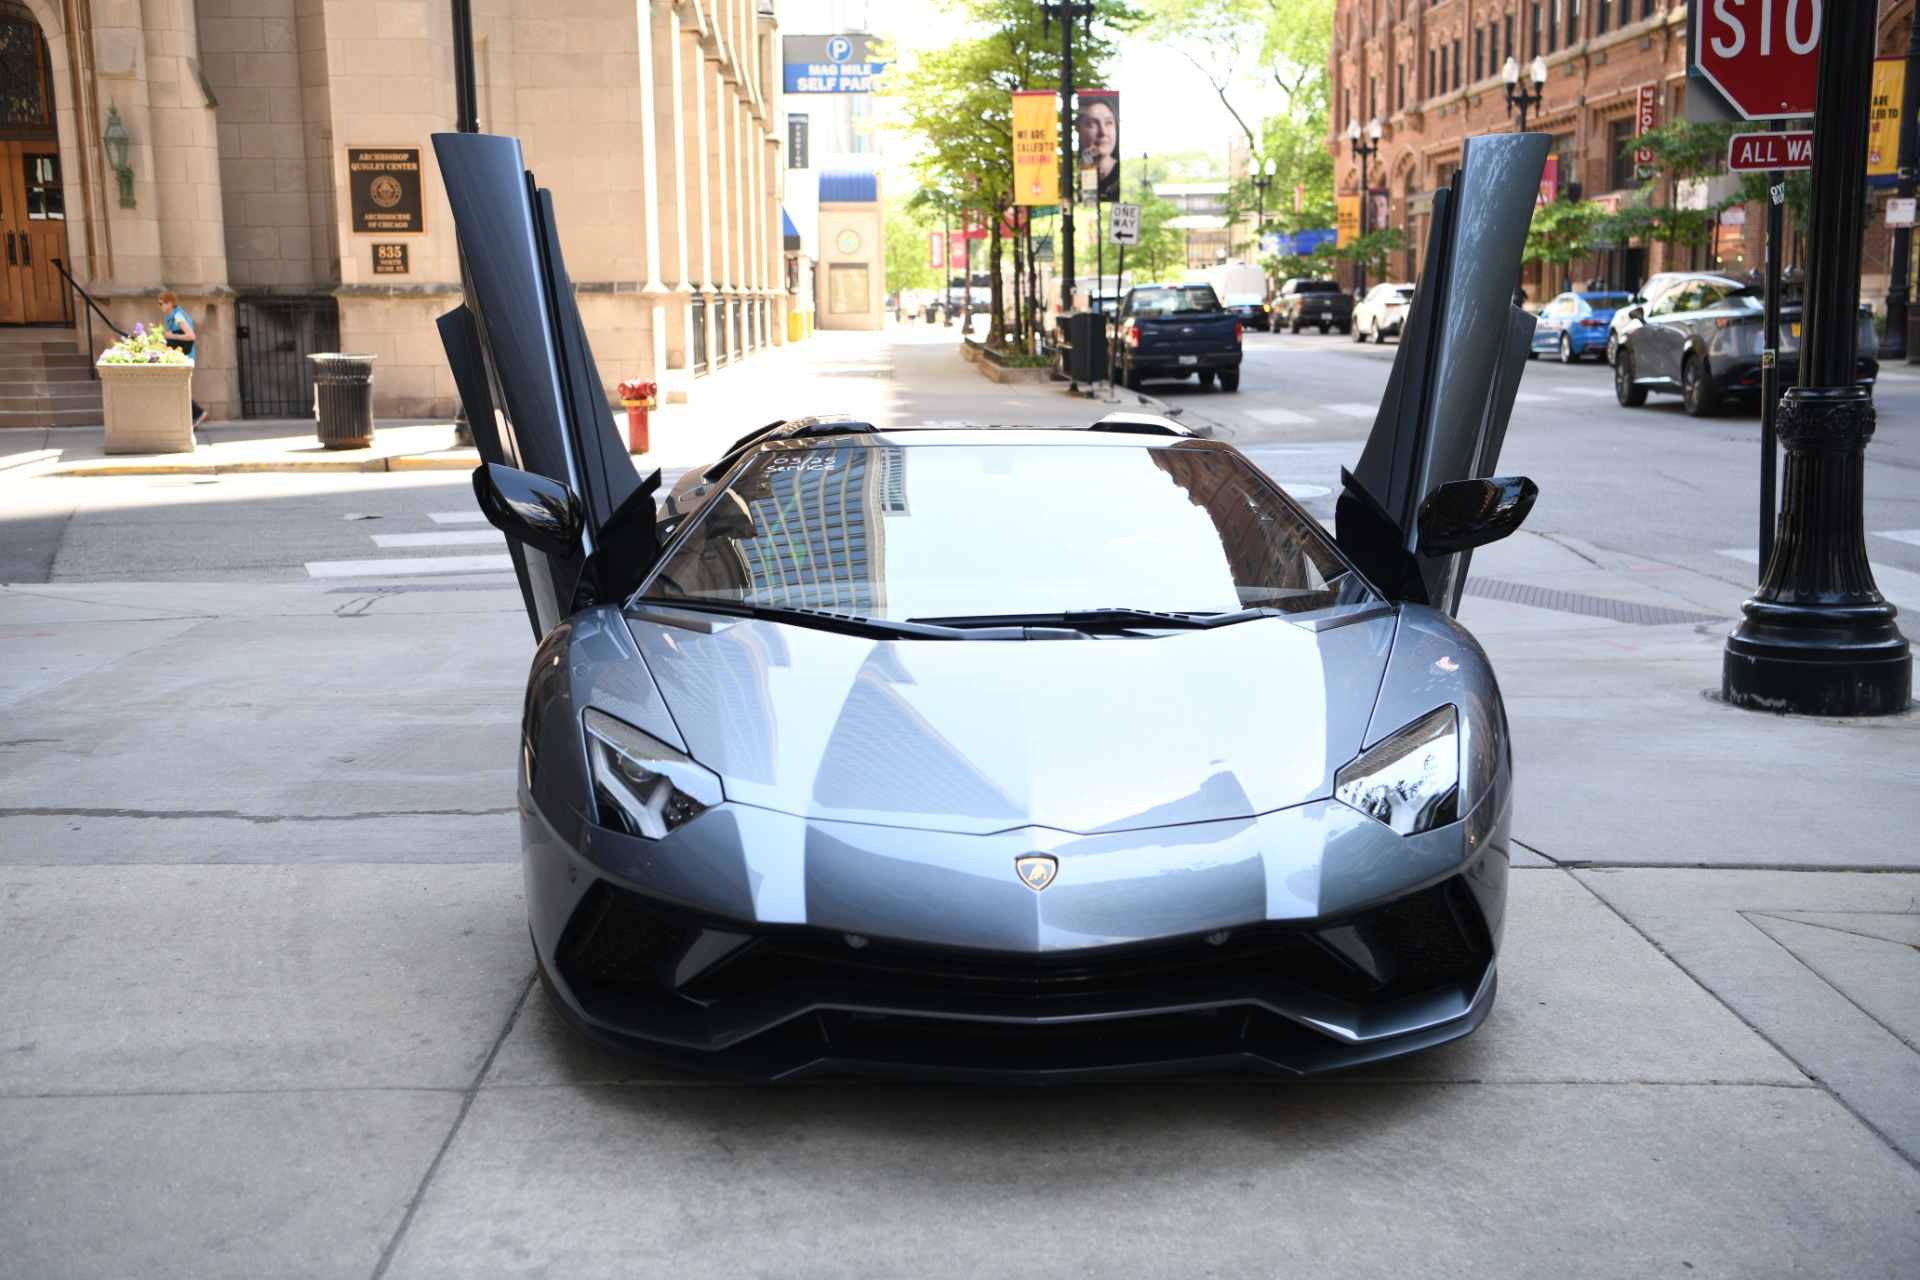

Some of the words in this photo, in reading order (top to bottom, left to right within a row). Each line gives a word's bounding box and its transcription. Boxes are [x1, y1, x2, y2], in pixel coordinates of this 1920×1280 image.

[1710, 0, 1822, 58] STO
[833, 40, 847, 58] P
[808, 64, 838, 76] MAG
[841, 64, 872, 76] MILE
[797, 77, 836, 91] SELF
[840, 77, 881, 91] PAR
[1873, 96, 1888, 106] ARE
[1888, 109, 1898, 119] TO
[1017, 131, 1028, 139] WE
[1031, 130, 1045, 139] ARE
[1045, 142, 1054, 151] TO
[1740, 142, 1778, 162] ALL
[1787, 140, 1813, 161] WA
[359, 153, 409, 161] ARCHBISHOP
[351, 163, 385, 171] QUIGLEY
[1114, 207, 1136, 218] ONE
[1113, 219, 1136, 229] WAY
[378, 246, 402, 258] 835
